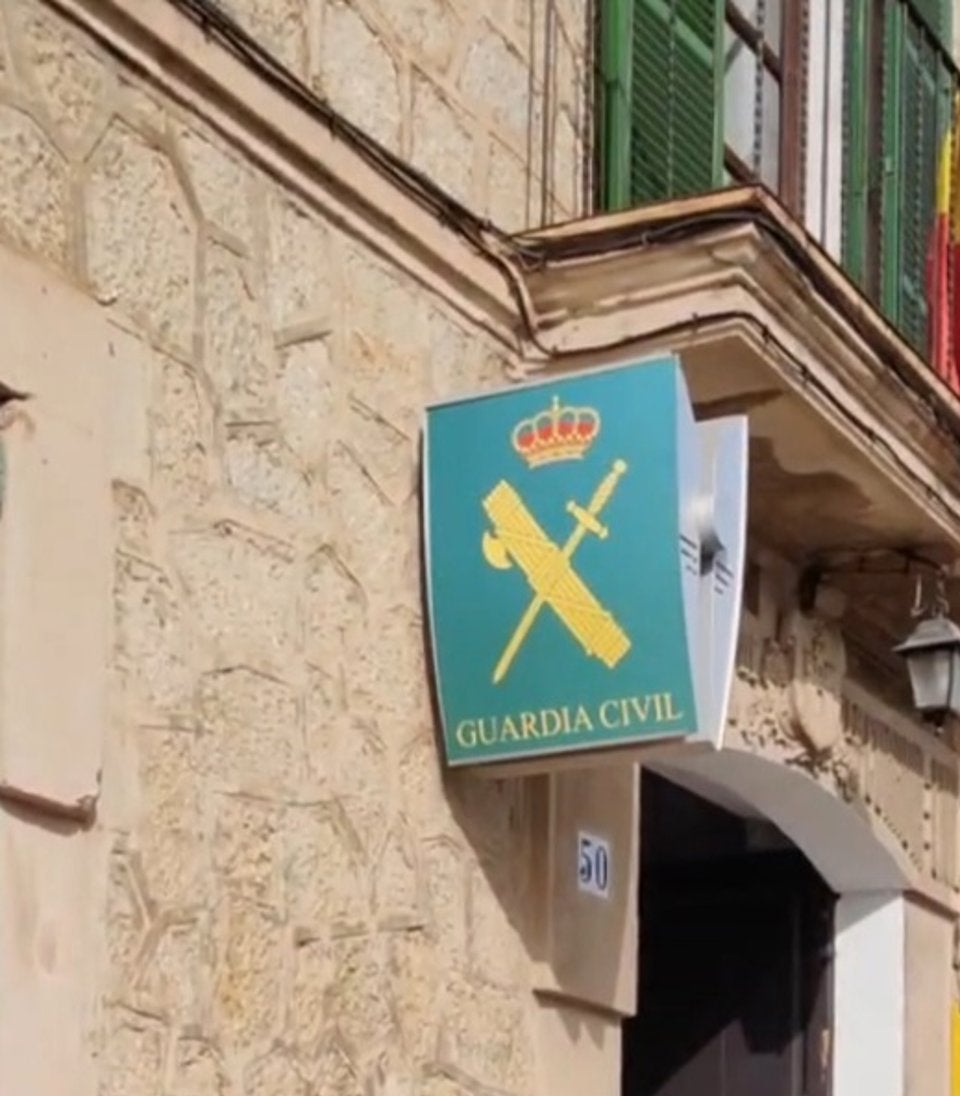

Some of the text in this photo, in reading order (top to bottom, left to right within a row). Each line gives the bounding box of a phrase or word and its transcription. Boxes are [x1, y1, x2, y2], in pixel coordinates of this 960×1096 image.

[456, 692, 684, 748] GUARDIA CIVIL
[579, 838, 608, 891] 50
